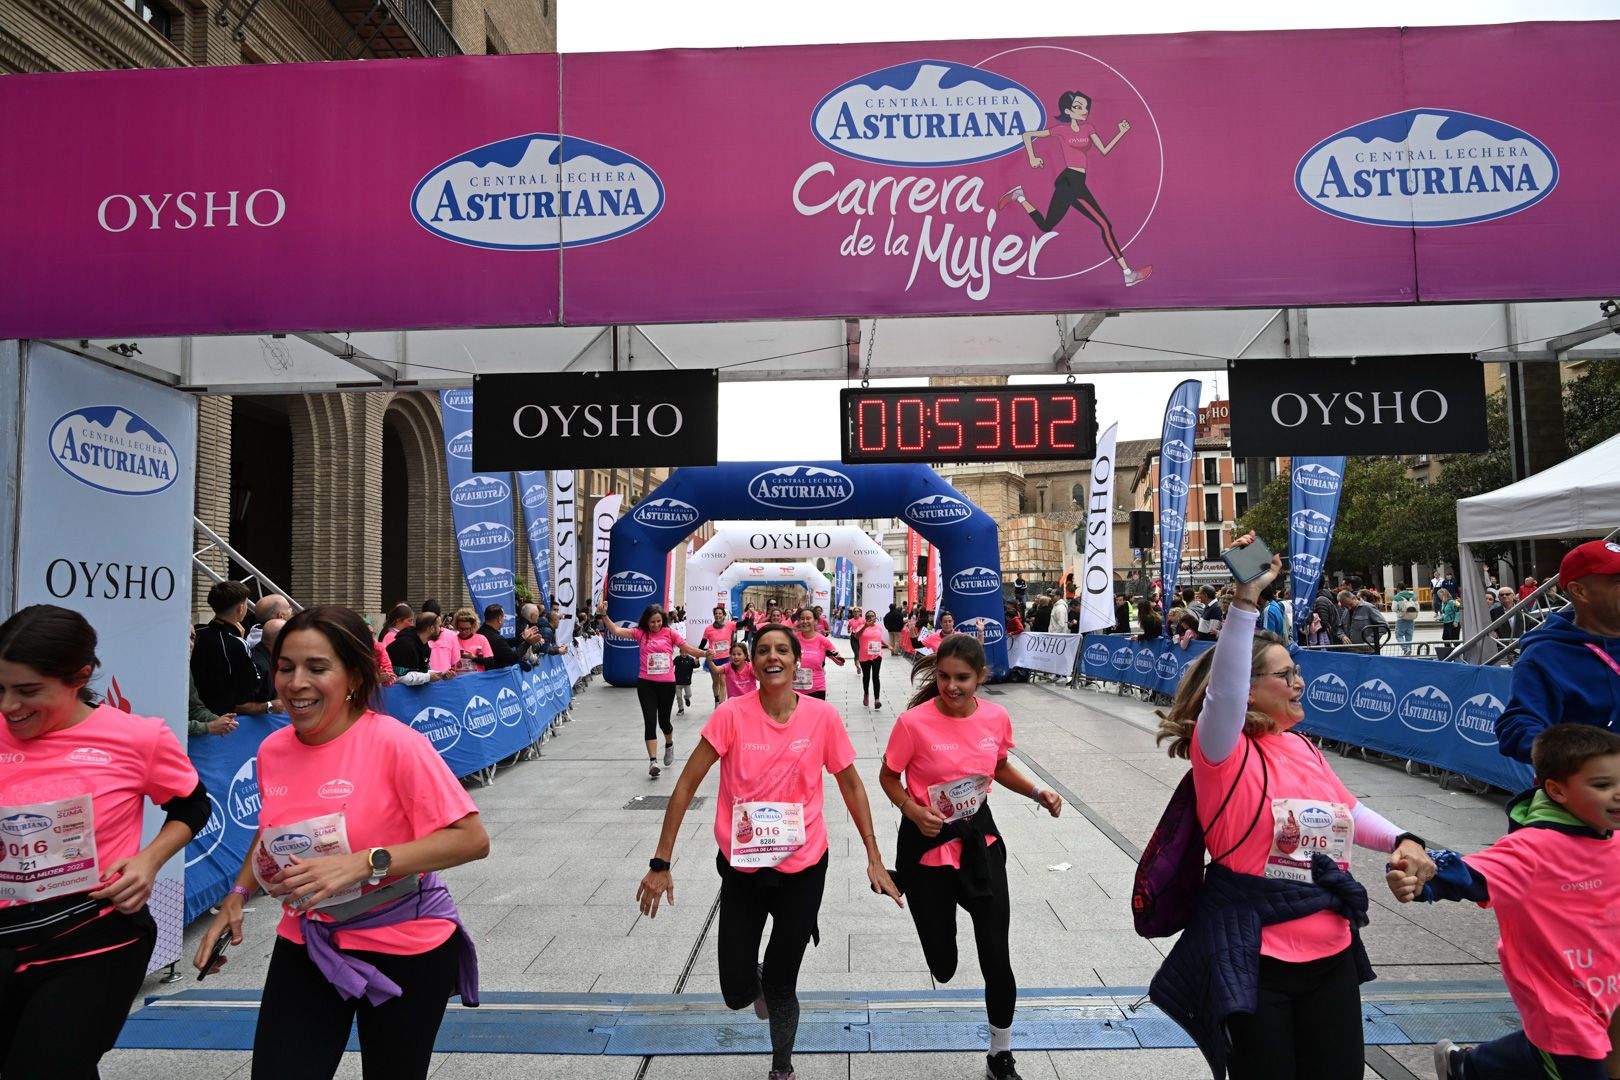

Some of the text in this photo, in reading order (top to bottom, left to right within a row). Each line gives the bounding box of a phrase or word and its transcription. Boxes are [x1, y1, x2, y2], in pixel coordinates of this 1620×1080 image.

[865, 95, 1019, 108] CENTRAL LECHERA
[829, 101, 1027, 140] ASTURIANA
[1355, 146, 1529, 163] CENTRAL LECHERA
[470, 171, 636, 188] CENTRAL LECHERA
[1316, 155, 1539, 199] ASTURIANA
[792, 161, 984, 216] Carrera
[97, 188, 286, 233] OYSHO
[431, 180, 645, 222] ASTURIANA
[840, 208, 1059, 301] de la Mujer
[1271, 389, 1449, 427] OYSHO
[512, 403, 683, 439] OYSHO
[82, 428, 168, 456] CENTRAL LECHERA
[59, 426, 170, 481] ASTURIANA
[756, 479, 846, 499] ASTURIANA
[637, 507, 694, 522] ASTURIANA
[910, 507, 968, 520] ASTURIANA
[1086, 454, 1111, 596] OYSHO
[749, 532, 831, 550] OYSHO
[46, 558, 175, 602] OYSHO
[1026, 635, 1067, 656] OYSHO
[1309, 684, 1344, 704] ASTURIANA
[1353, 691, 1391, 713] ASTURIANA
[1401, 699, 1447, 723] ASTURIANA
[1458, 707, 1496, 735] ASTURIA
[956, 796, 977, 811] 016
[755, 827, 780, 837] 016
[1301, 835, 1327, 848] 016
[9, 840, 48, 858] 016
[47, 875, 89, 890] Santander
[1273, 869, 1306, 881] OYSHO
[1560, 879, 1602, 891] OYSHO
[1563, 948, 1593, 971] TU
